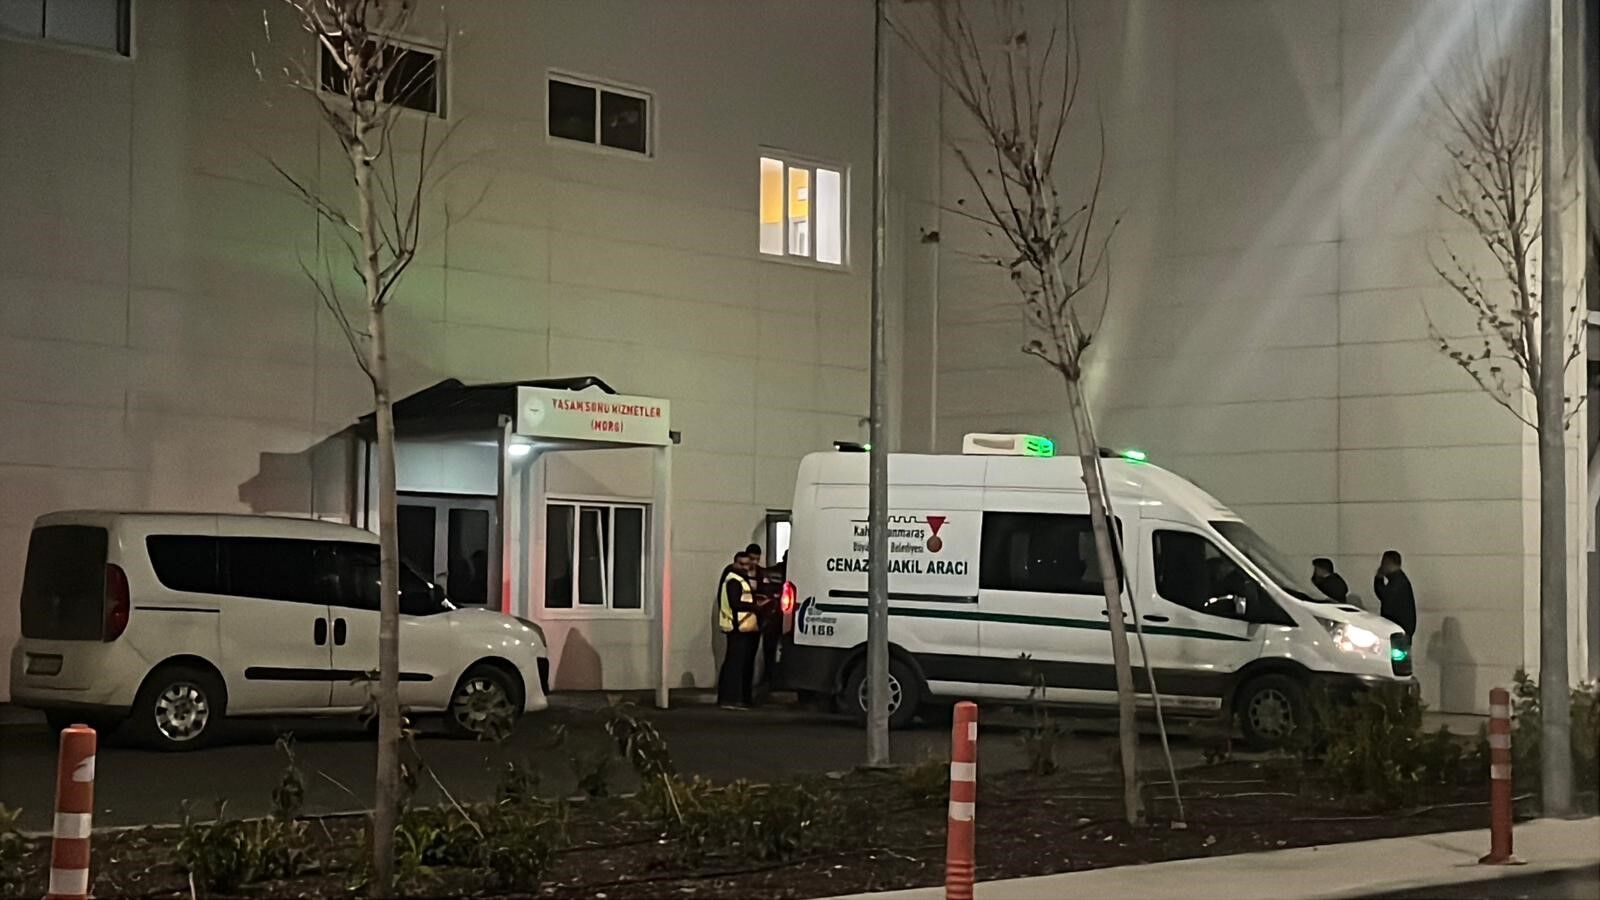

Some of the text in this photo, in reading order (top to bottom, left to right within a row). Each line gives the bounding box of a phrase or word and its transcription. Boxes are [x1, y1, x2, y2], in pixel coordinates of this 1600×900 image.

[585, 401, 610, 414] SONU
[826, 558, 870, 573] CENAZ
[926, 560, 968, 575] ARACI
